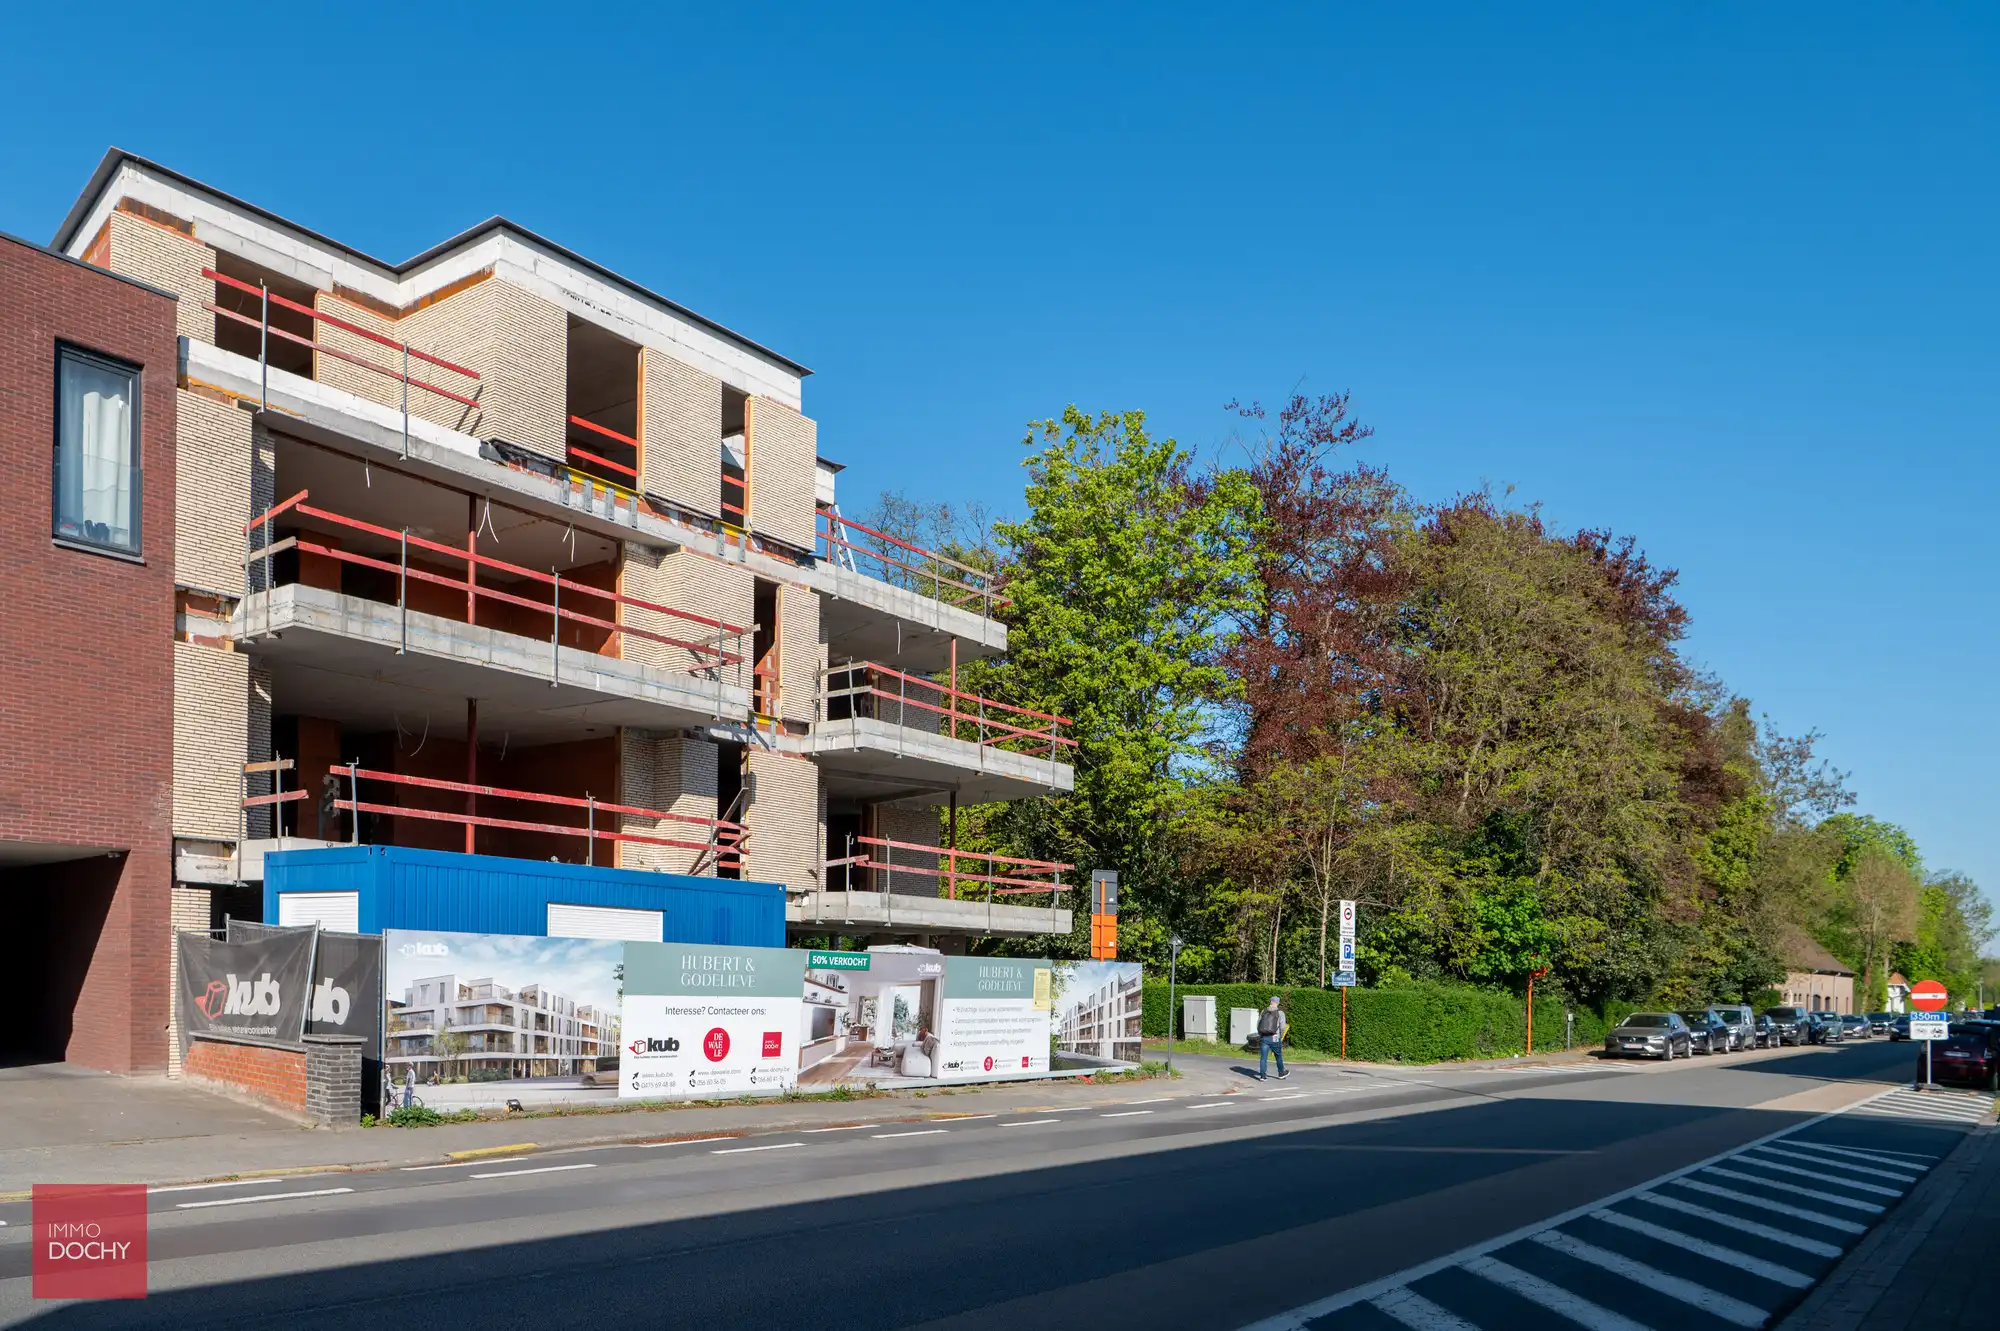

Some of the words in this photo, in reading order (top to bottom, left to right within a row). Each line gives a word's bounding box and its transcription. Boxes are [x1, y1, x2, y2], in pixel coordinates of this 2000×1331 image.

[416, 942, 449, 956] kub
[682, 955, 741, 971] HUBERT
[745, 957, 756, 972] &
[812, 955, 828, 965] 50%
[829, 956, 868, 967] VERKOCHT
[925, 962, 941, 973] kub
[979, 965, 1014, 978] HUBERT
[1016, 967, 1024, 979] &
[681, 973, 756, 987] GODELIEVE
[978, 979, 1025, 992] GODELIEVE
[224, 973, 281, 1016] kub
[309, 977, 350, 1026] ub
[665, 1006, 705, 1016] Interesse?
[707, 1006, 749, 1016] Contacteer
[751, 1008, 767, 1016] ons:
[1910, 1011, 1940, 1021] 350m
[713, 1033, 723, 1041] DE
[647, 1037, 680, 1052] kub
[708, 1041, 723, 1049] WAE
[713, 1049, 723, 1057] LE
